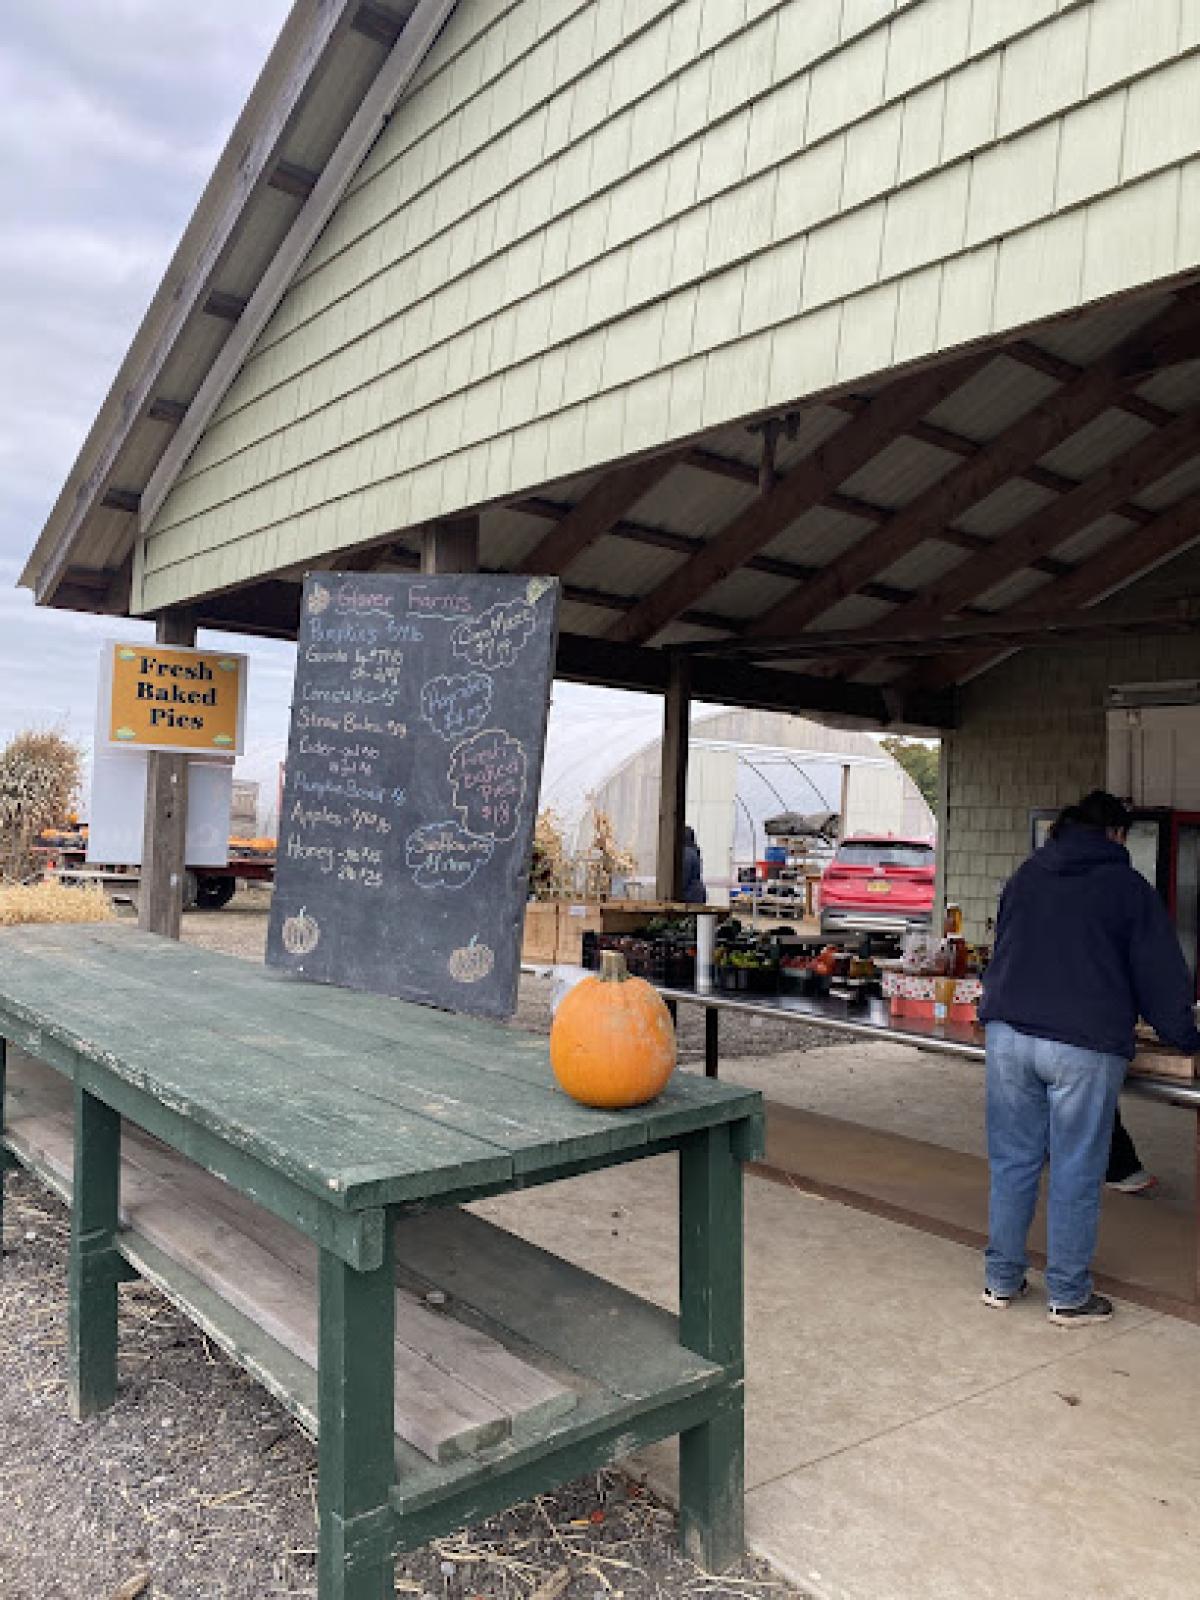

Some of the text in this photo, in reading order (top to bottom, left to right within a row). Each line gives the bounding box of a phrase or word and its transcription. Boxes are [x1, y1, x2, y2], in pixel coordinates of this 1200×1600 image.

[140, 656, 213, 681] Fresh
[136, 682, 218, 706] Baked
[149, 708, 204, 730] Pies
[287, 832, 333, 874] Honey
